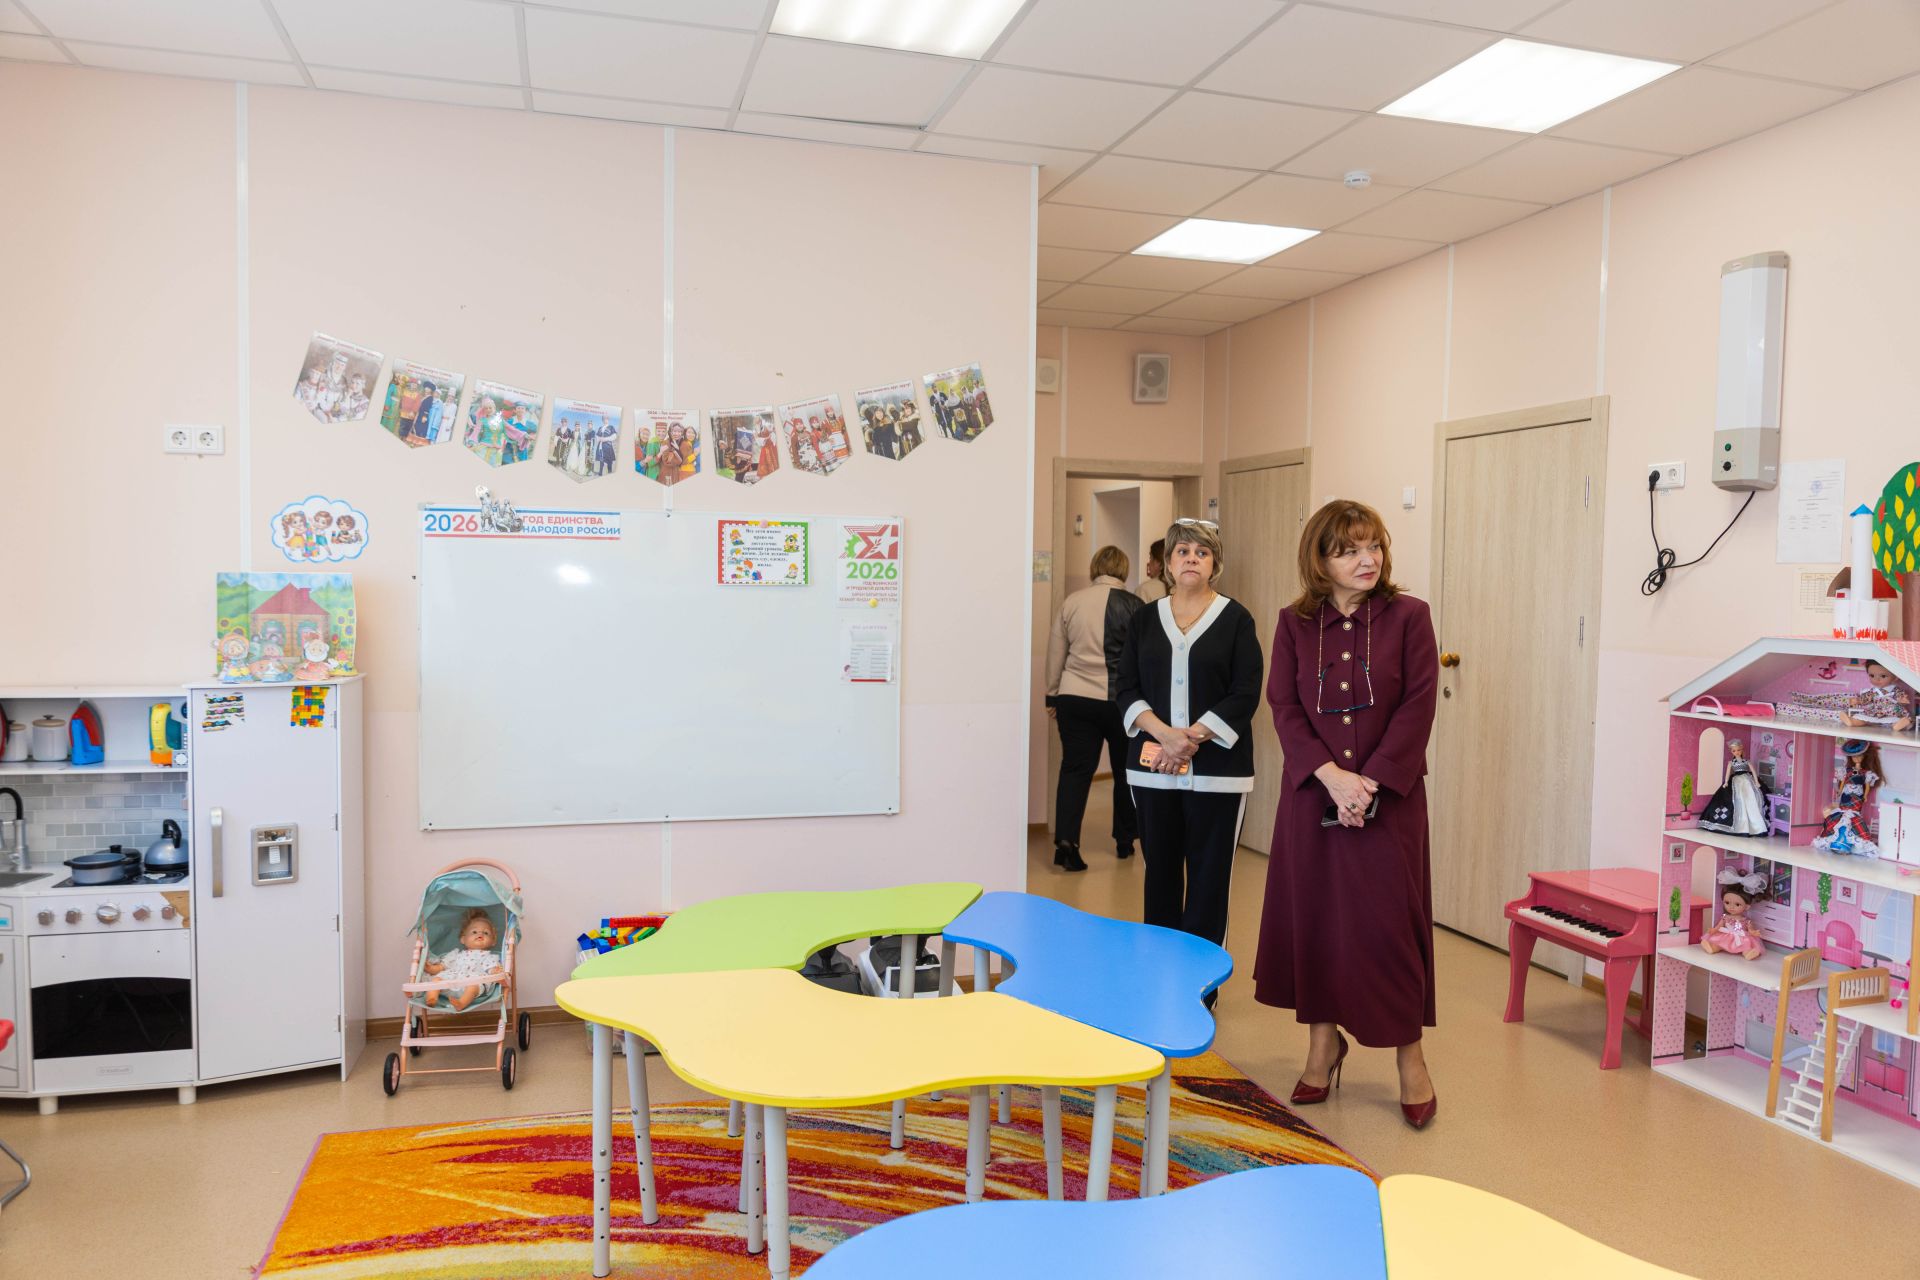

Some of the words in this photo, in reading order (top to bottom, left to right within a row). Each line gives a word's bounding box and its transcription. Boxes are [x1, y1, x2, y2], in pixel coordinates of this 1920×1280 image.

[424, 513, 479, 532] 2026
[522, 515, 544, 525] ГОД
[547, 516, 604, 526] ЕДИНСТВА
[522, 524, 574, 534] НАРОДОВ
[576, 526, 621, 535] РОССИИ
[846, 562, 898, 580] 2026
